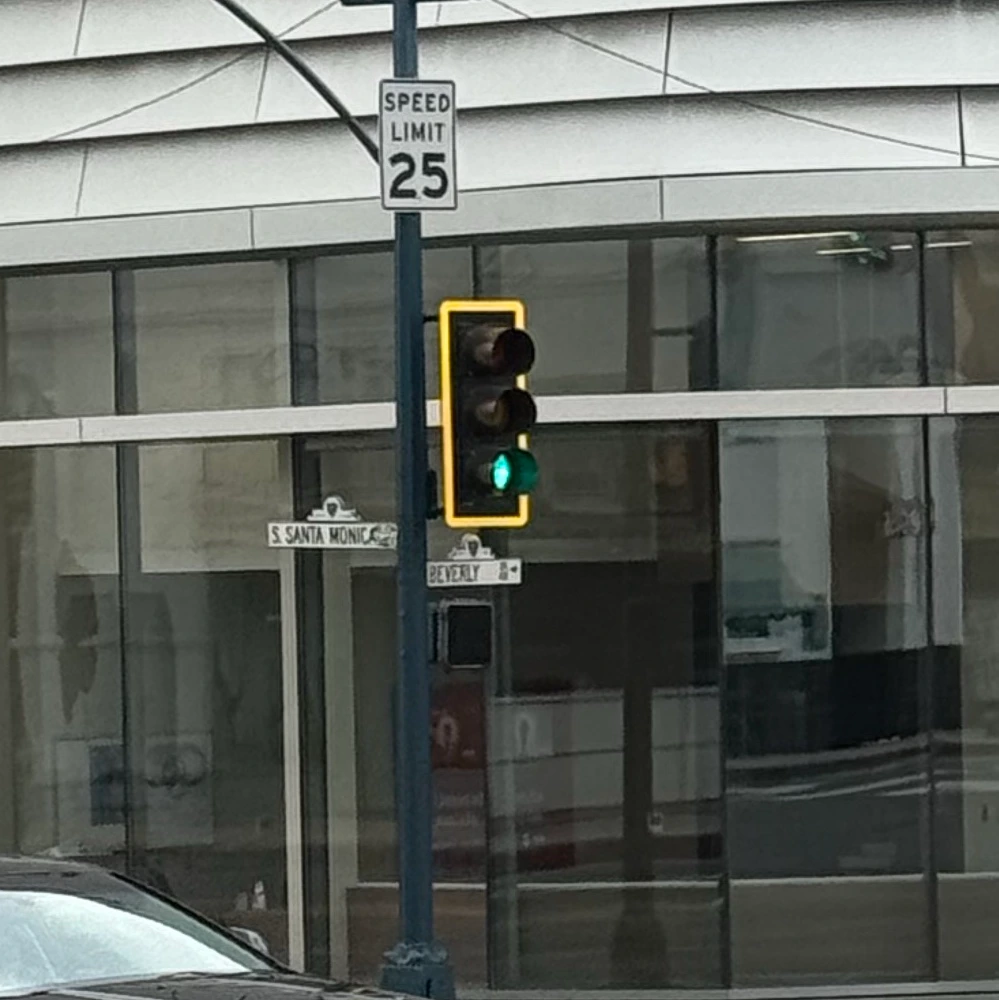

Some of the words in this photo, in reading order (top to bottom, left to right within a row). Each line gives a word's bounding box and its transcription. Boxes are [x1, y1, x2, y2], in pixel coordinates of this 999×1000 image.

[384, 92, 450, 112] SPEED
[391, 122, 446, 142] LIMIT
[388, 152, 448, 199] 25
[285, 525, 324, 545] SANTA
[429, 563, 480, 583] BEVERLY
